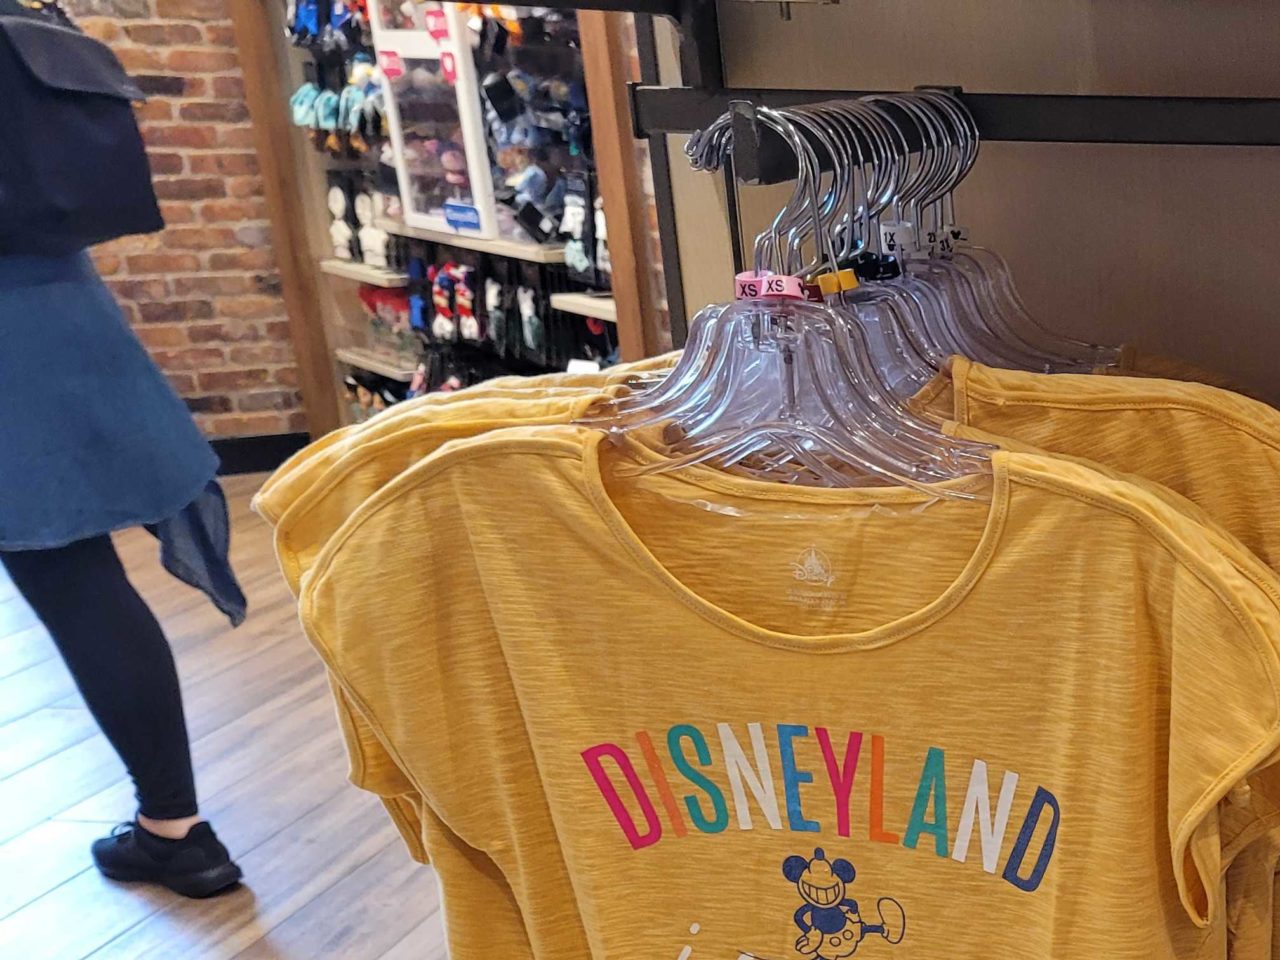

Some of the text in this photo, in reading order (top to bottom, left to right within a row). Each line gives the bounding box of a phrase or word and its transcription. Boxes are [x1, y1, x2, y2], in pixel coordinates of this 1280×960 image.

[884, 232, 896, 244] 1X
[739, 283, 758, 298] XS
[766, 279, 785, 293] XS
[580, 722, 1061, 893] DISNEYLAND
